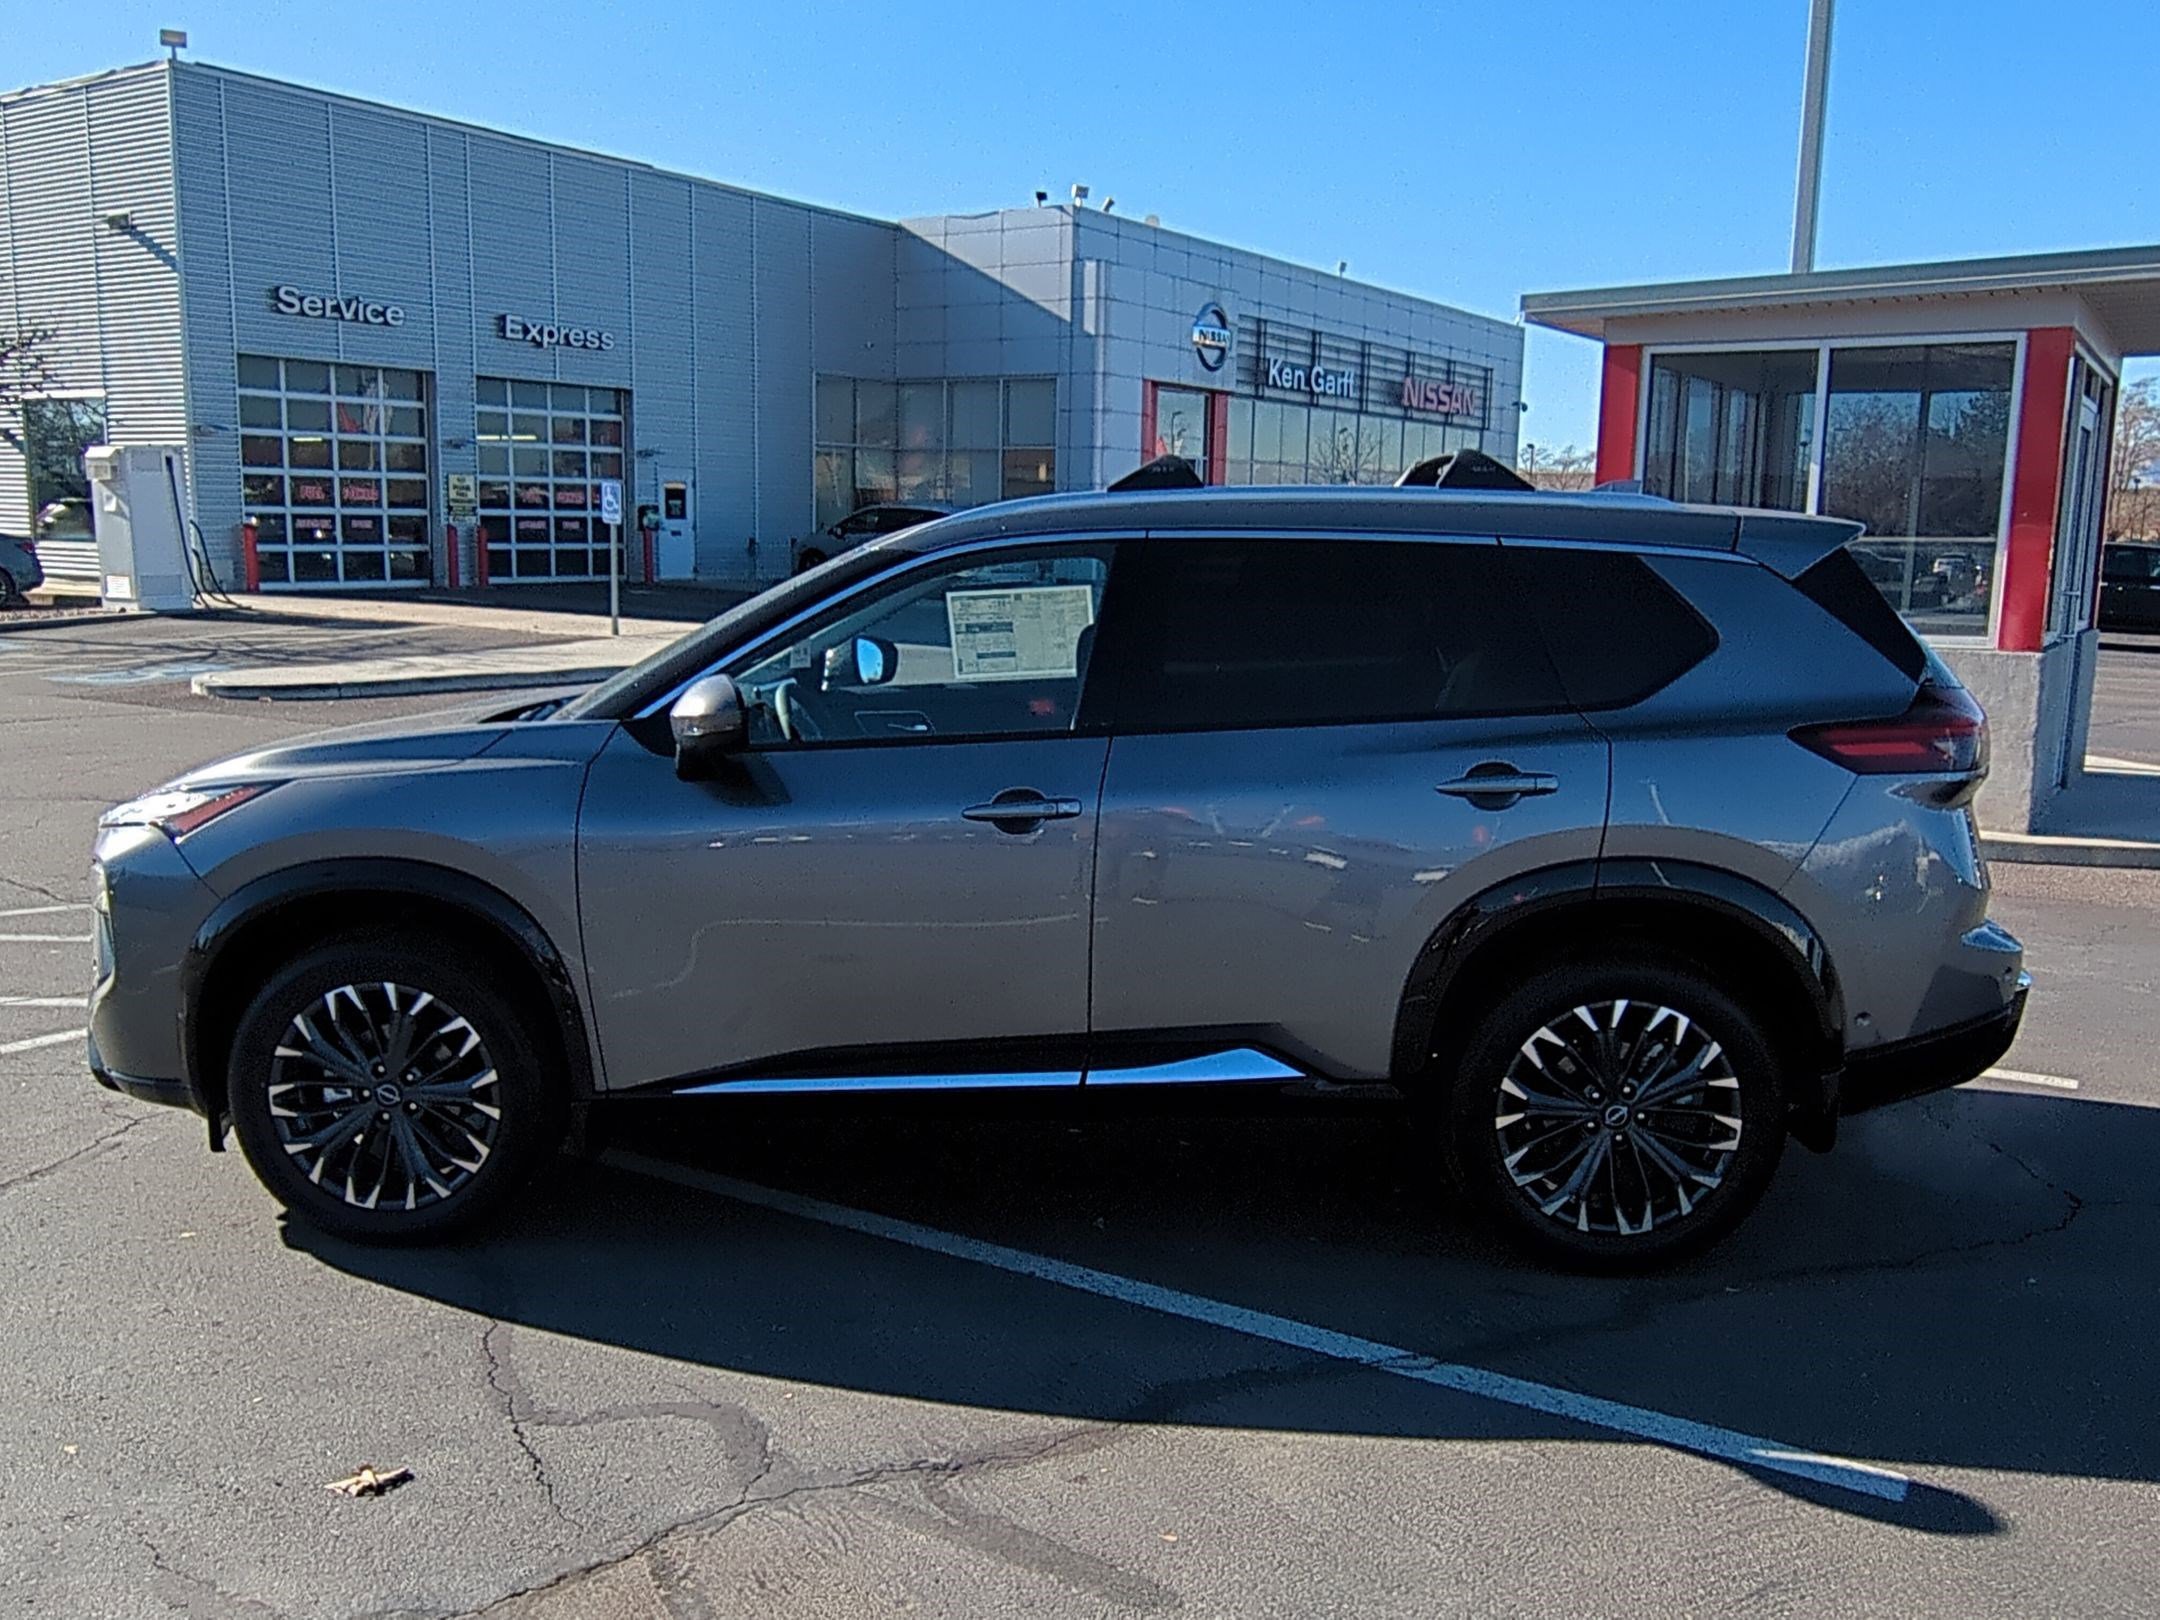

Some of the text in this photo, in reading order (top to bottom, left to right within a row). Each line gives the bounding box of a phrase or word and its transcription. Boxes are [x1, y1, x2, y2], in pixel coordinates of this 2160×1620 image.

[276, 285, 405, 326] Service
[504, 314, 615, 350] Express
[1268, 356, 1355, 398] Ken Garff
[1402, 376, 1475, 415] NISSAN
